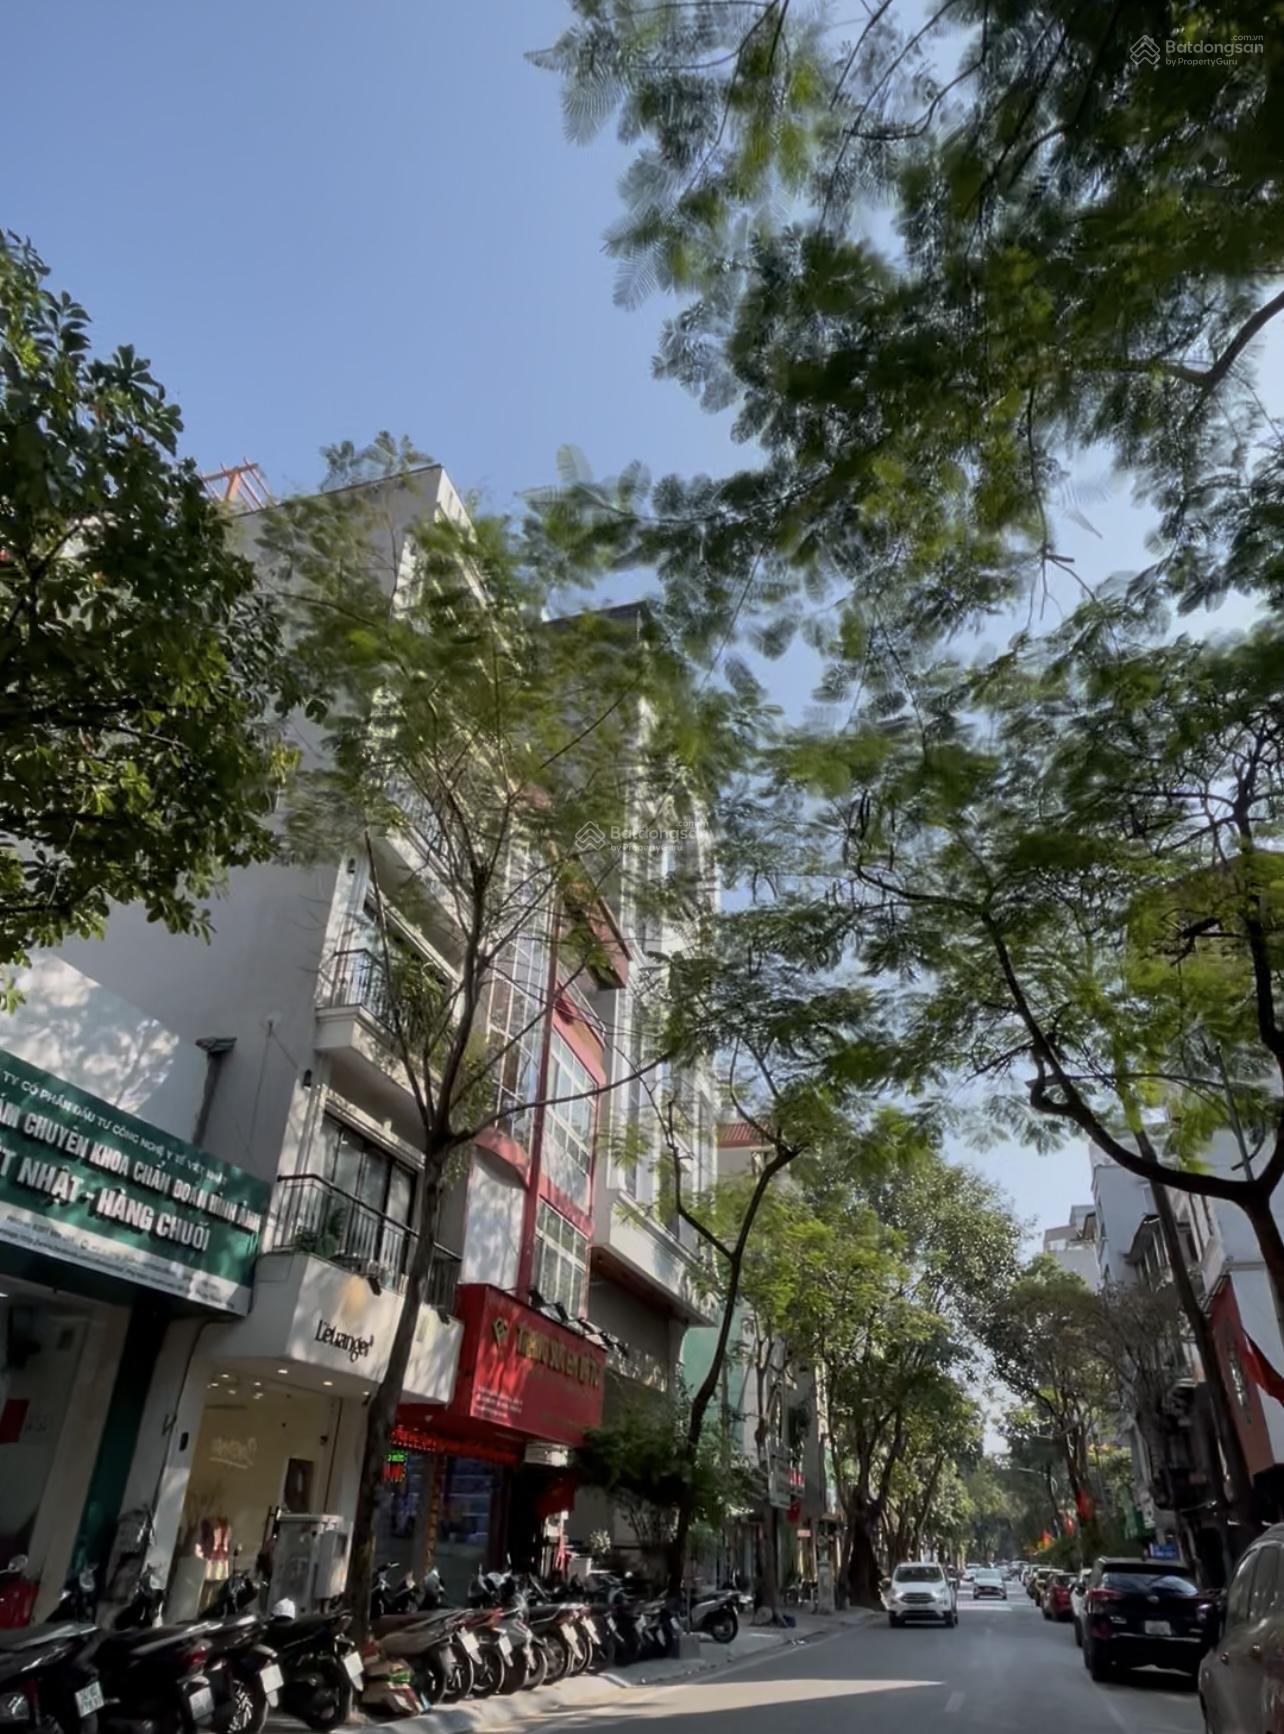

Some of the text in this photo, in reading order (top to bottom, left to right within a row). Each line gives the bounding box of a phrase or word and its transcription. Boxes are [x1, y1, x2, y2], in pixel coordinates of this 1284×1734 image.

[2, 1070, 20, 1085] TY
[24, 1112, 90, 1158] CHUYÊN
[89, 1142, 130, 1177] KHOA
[17, 1156, 85, 1205] NHẬT
[97, 1185, 155, 1232] HÀNG
